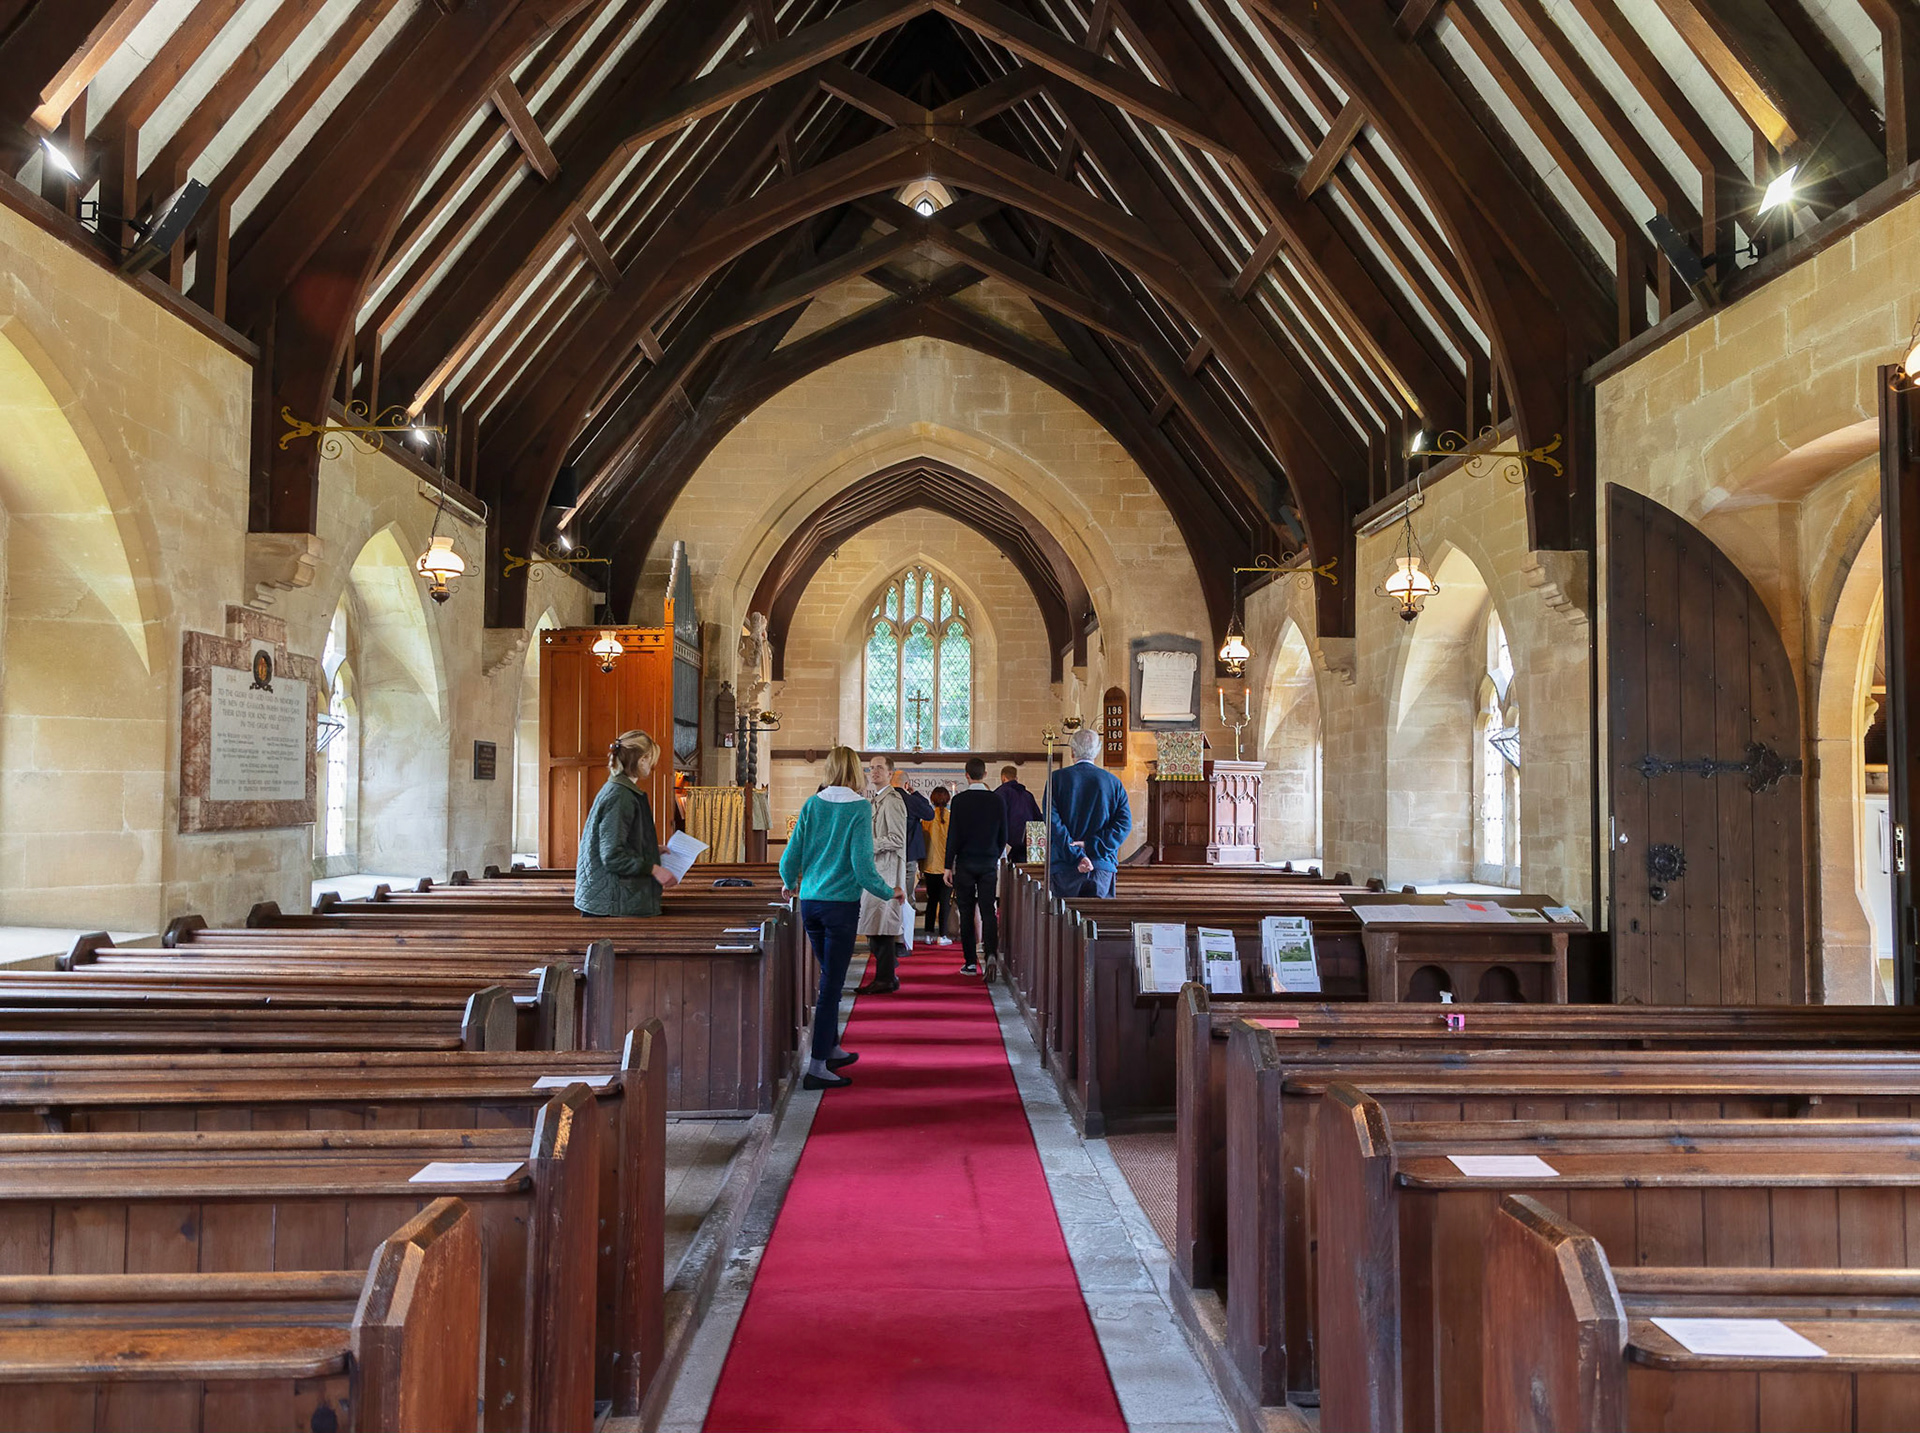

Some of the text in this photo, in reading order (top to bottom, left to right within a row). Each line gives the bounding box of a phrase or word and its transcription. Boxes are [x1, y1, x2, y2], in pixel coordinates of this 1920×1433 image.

[1108, 706, 1122, 715] 198
[1108, 718, 1122, 727] 197
[1108, 730, 1123, 739] 160
[1108, 742, 1123, 751] 275
